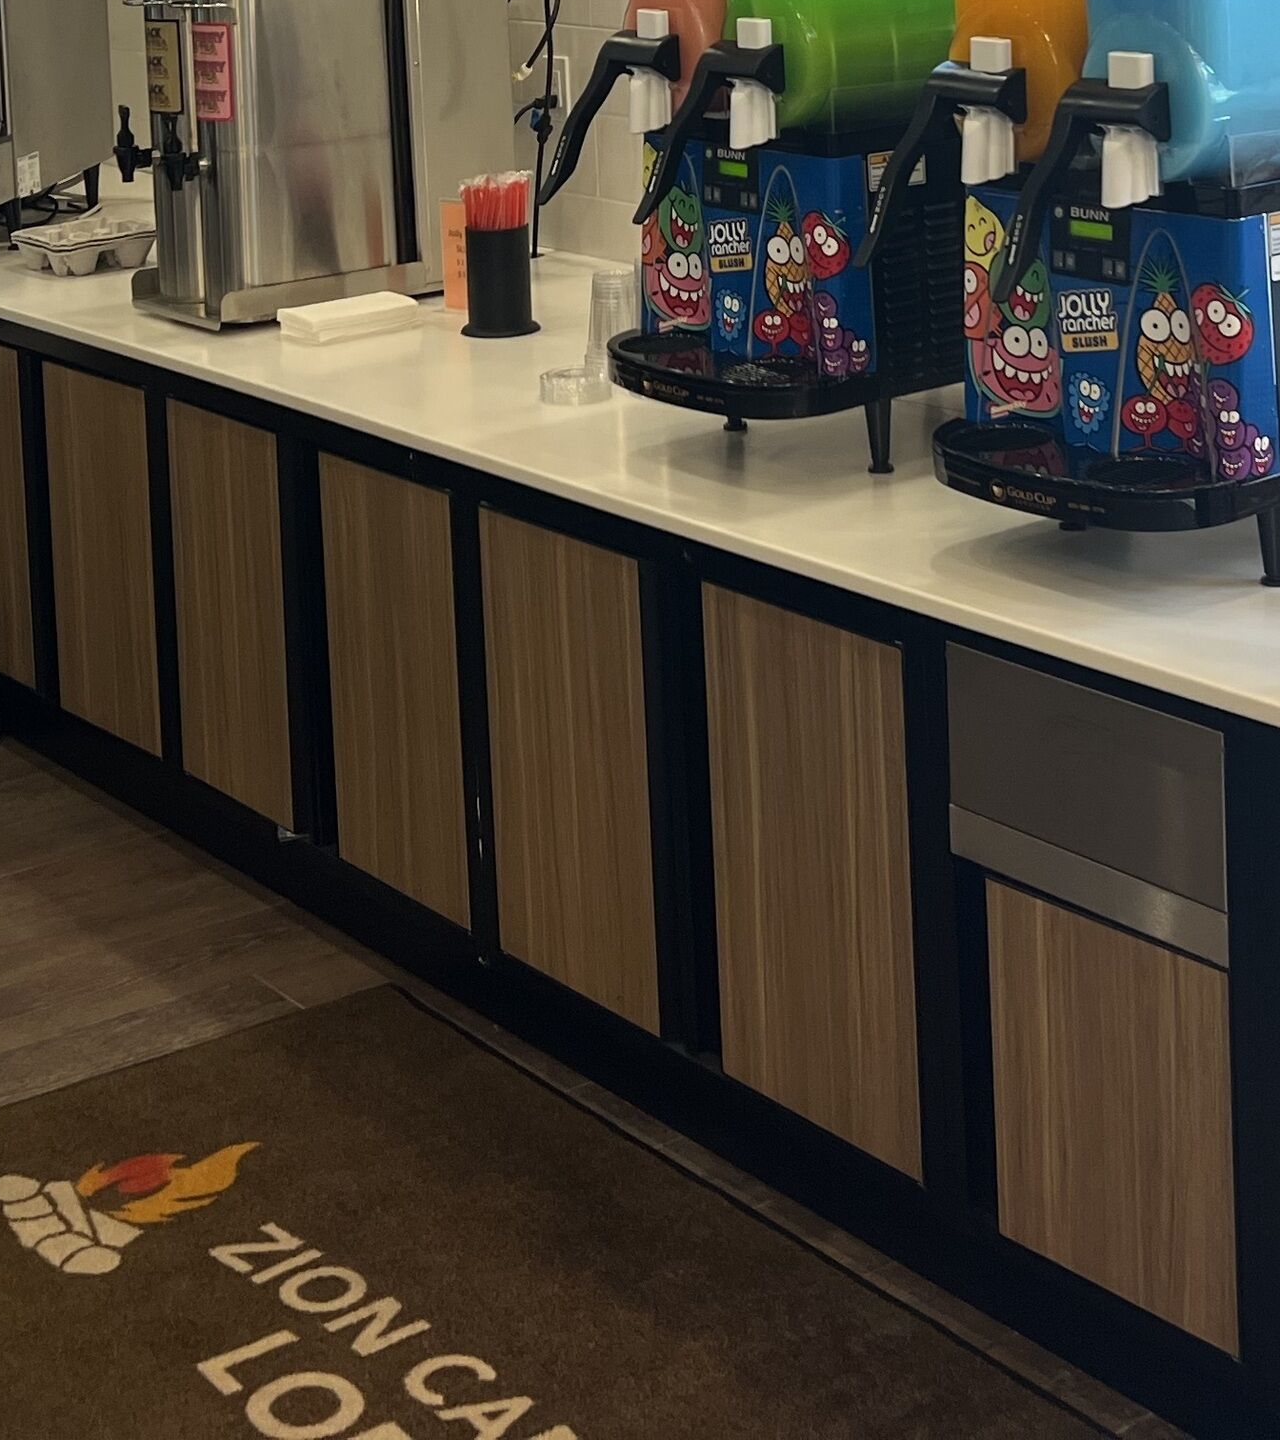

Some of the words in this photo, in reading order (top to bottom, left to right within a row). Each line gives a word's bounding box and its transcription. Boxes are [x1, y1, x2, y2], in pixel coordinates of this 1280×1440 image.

[717, 148, 746, 160] BUNN
[1070, 206, 1110, 222] BUNN
[709, 220, 747, 244] JOLLY
[711, 240, 751, 257] rancher
[719, 257, 745, 269] SLUSH
[1058, 292, 1110, 318] JOLLY
[1062, 313, 1116, 333] rancher
[1071, 335, 1108, 349] SLUSH
[1007, 485, 1034, 503] GOLD
[1034, 491, 1057, 507] CUP
[208, 1222, 431, 1357] ZION
[404, 1353, 583, 1440] CA
[197, 1329, 414, 1440] LO
